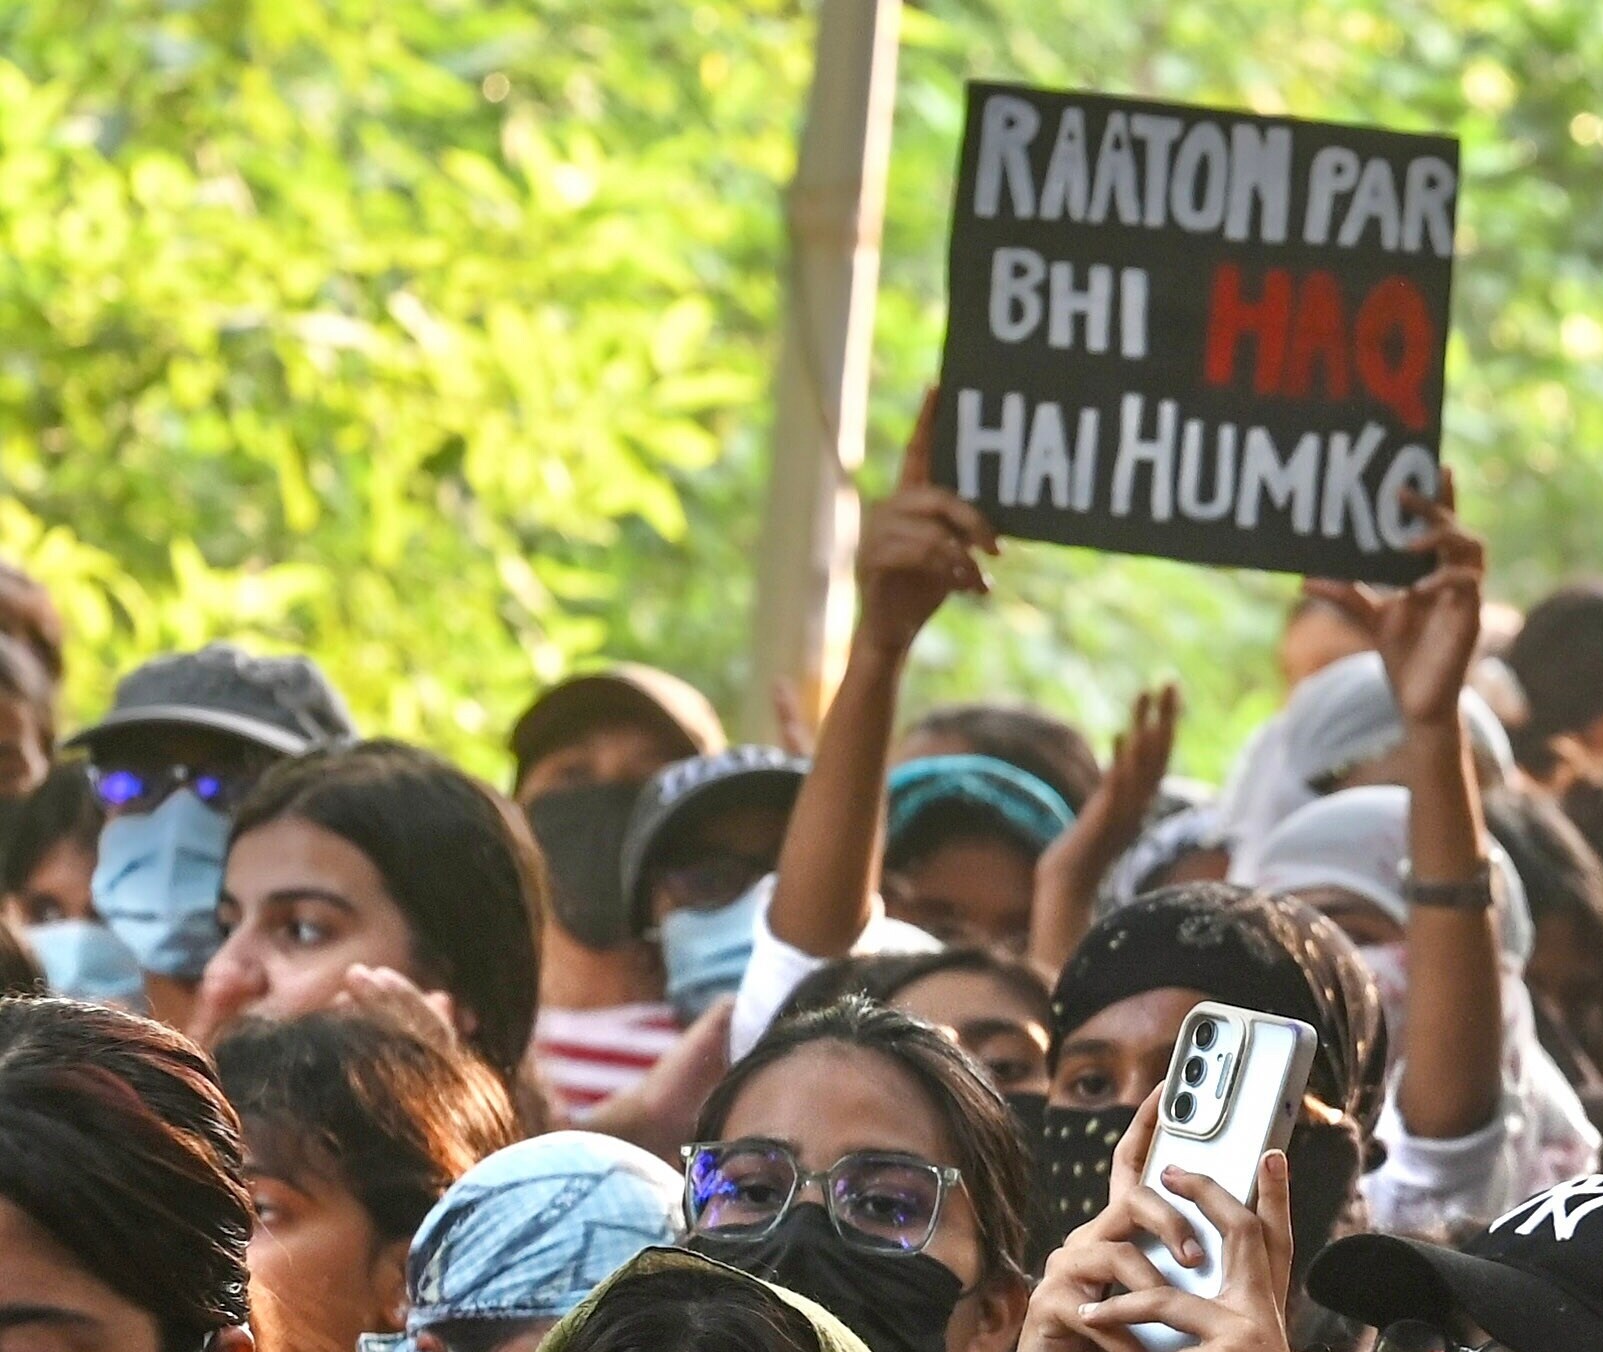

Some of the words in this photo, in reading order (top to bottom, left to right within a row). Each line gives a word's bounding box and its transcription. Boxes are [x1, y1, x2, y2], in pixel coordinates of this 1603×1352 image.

[1303, 146, 1458, 257] PAR
[988, 247, 1149, 361] BHI
[1204, 262, 1434, 430] HAQ
[955, 388, 1099, 514] HAI
